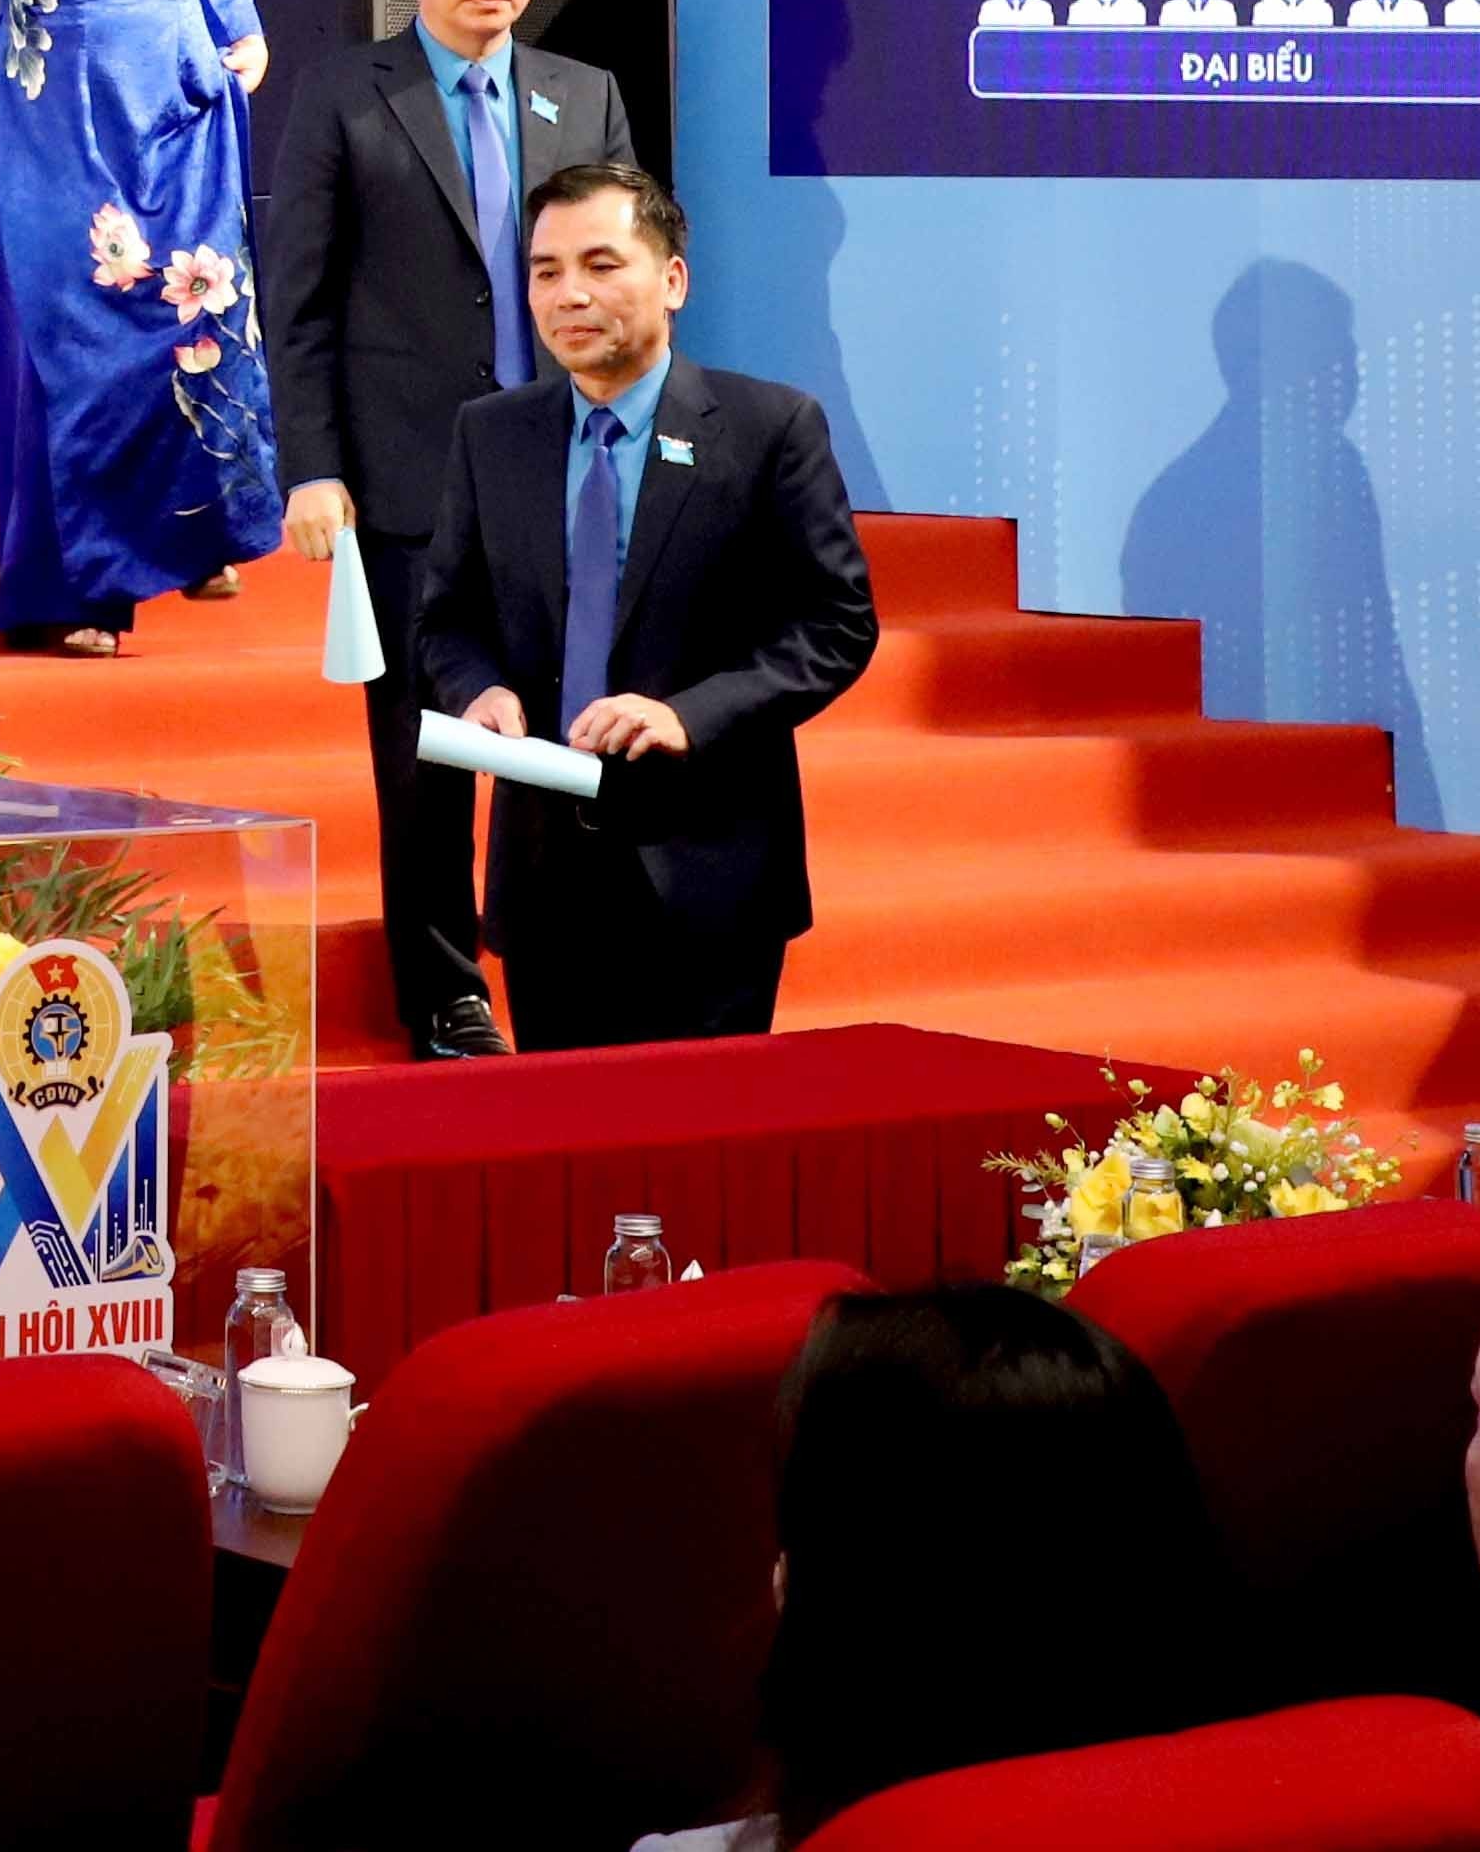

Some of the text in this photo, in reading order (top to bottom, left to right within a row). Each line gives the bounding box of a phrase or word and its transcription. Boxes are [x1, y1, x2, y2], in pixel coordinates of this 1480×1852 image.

[1180, 38, 1314, 88] ĐẠI BIỂU
[87, 1297, 165, 1349] XVIII
